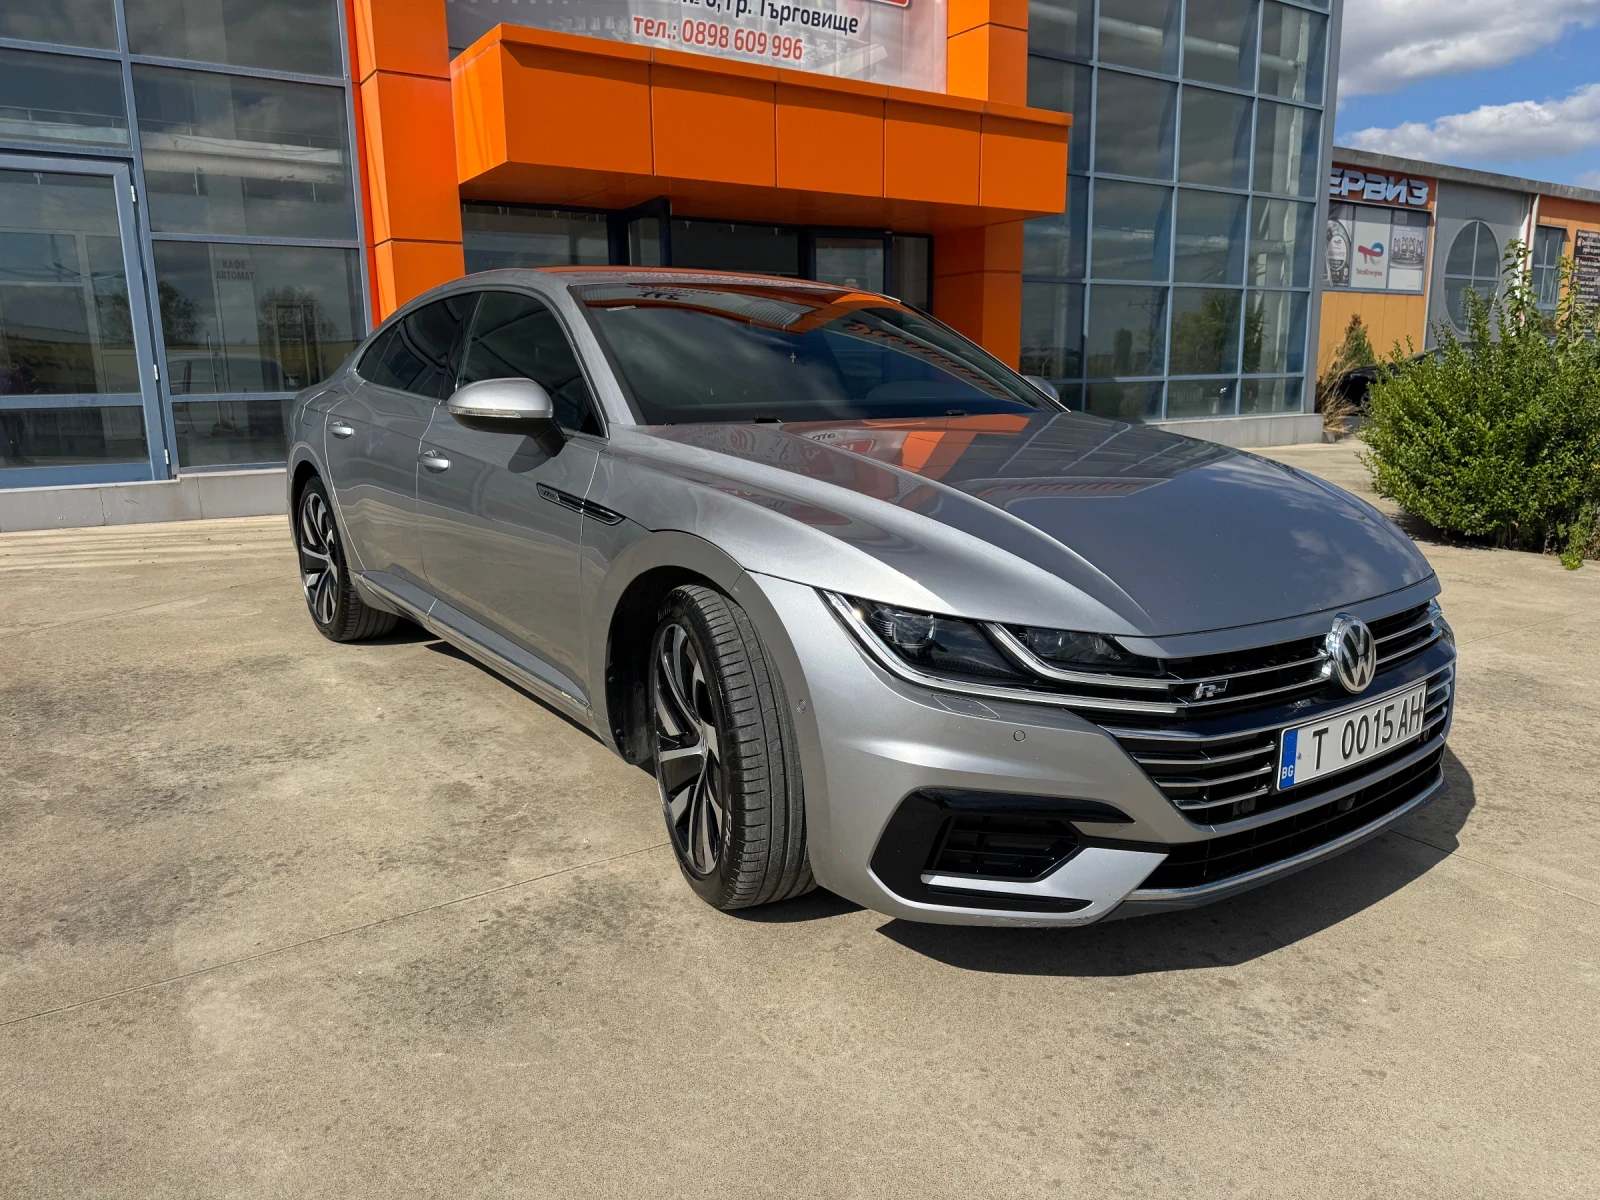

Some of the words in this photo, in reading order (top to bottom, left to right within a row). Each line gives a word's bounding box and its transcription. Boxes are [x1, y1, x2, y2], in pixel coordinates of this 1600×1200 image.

[758, 0, 859, 36] Търговище
[633, 16, 677, 40] тел.:
[682, 19, 730, 49] 0898
[734, 28, 768, 54] 609
[771, 35, 803, 60] 996
[215, 270, 255, 281] АВТОМАТ
[222, 259, 246, 270] КАФЕ
[1312, 727, 1329, 771] T
[1281, 764, 1295, 779] BG
